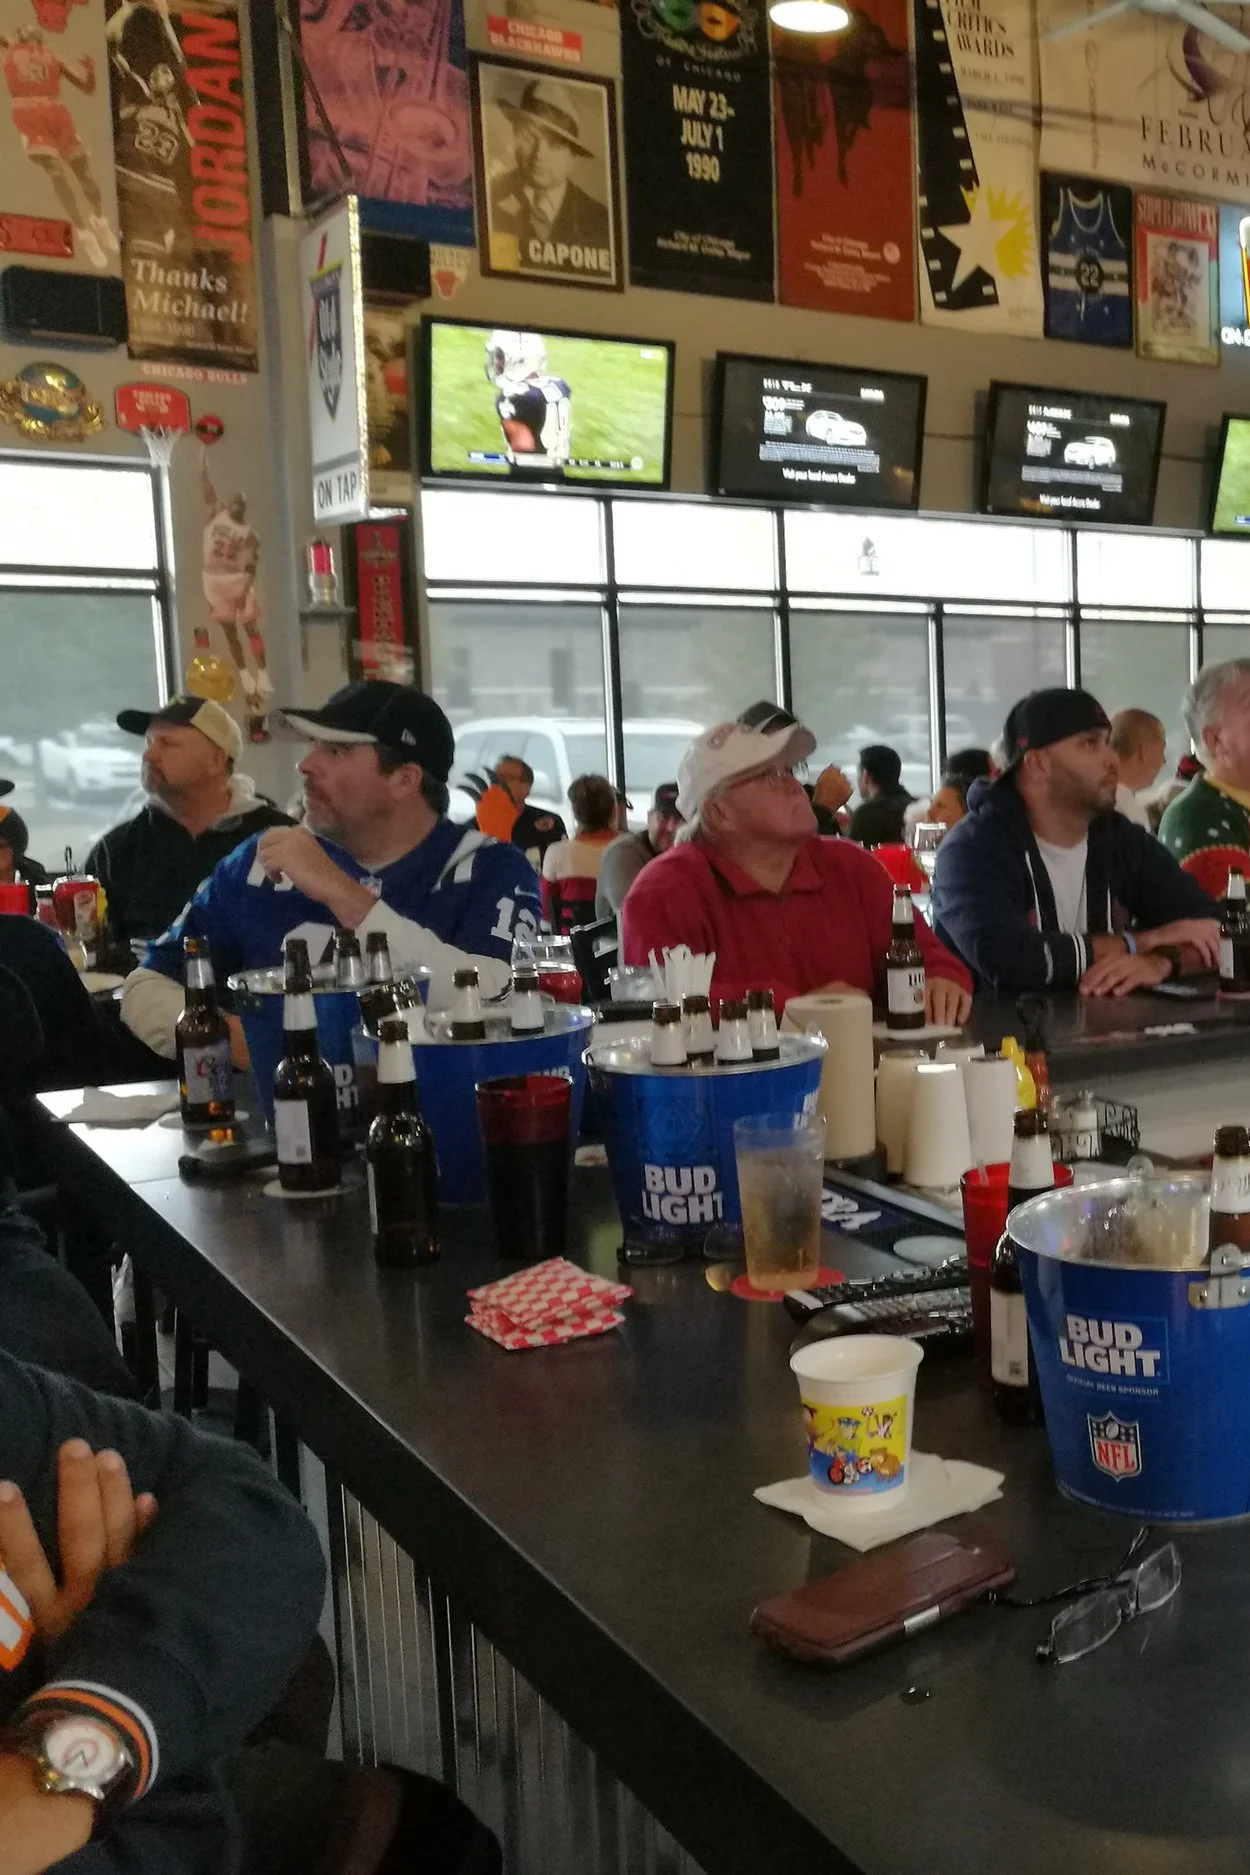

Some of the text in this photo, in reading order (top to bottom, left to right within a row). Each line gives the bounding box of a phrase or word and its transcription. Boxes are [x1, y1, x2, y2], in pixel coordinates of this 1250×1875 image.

[489, 31, 581, 63] BLACKHAWKS
[507, 20, 563, 45] CHICAGO
[953, 33, 1015, 59] AWARDS
[683, 60, 741, 83] CHICAGO
[672, 83, 706, 116] MAY
[181, 13, 252, 263] JORDAN
[680, 118, 724, 152] JULY 1
[685, 151, 720, 183] 1990
[528, 240, 611, 270] CAPONE
[131, 258, 228, 294] Thanks
[133, 288, 250, 323] Michael!
[142, 361, 248, 385] CHICAGO BULLS
[317, 471, 357, 507] ON TAP
[490, 896, 537, 943] 12
[644, 1163, 717, 1194] BUD
[642, 1192, 723, 1225] LIGHT
[1066, 1315, 1143, 1351] BUD
[1059, 1340, 1161, 1378] LIGHT
[1066, 1373, 1159, 1396] OFFICIAL BEER SPONSOR
[1095, 1440, 1136, 1470] NFL
